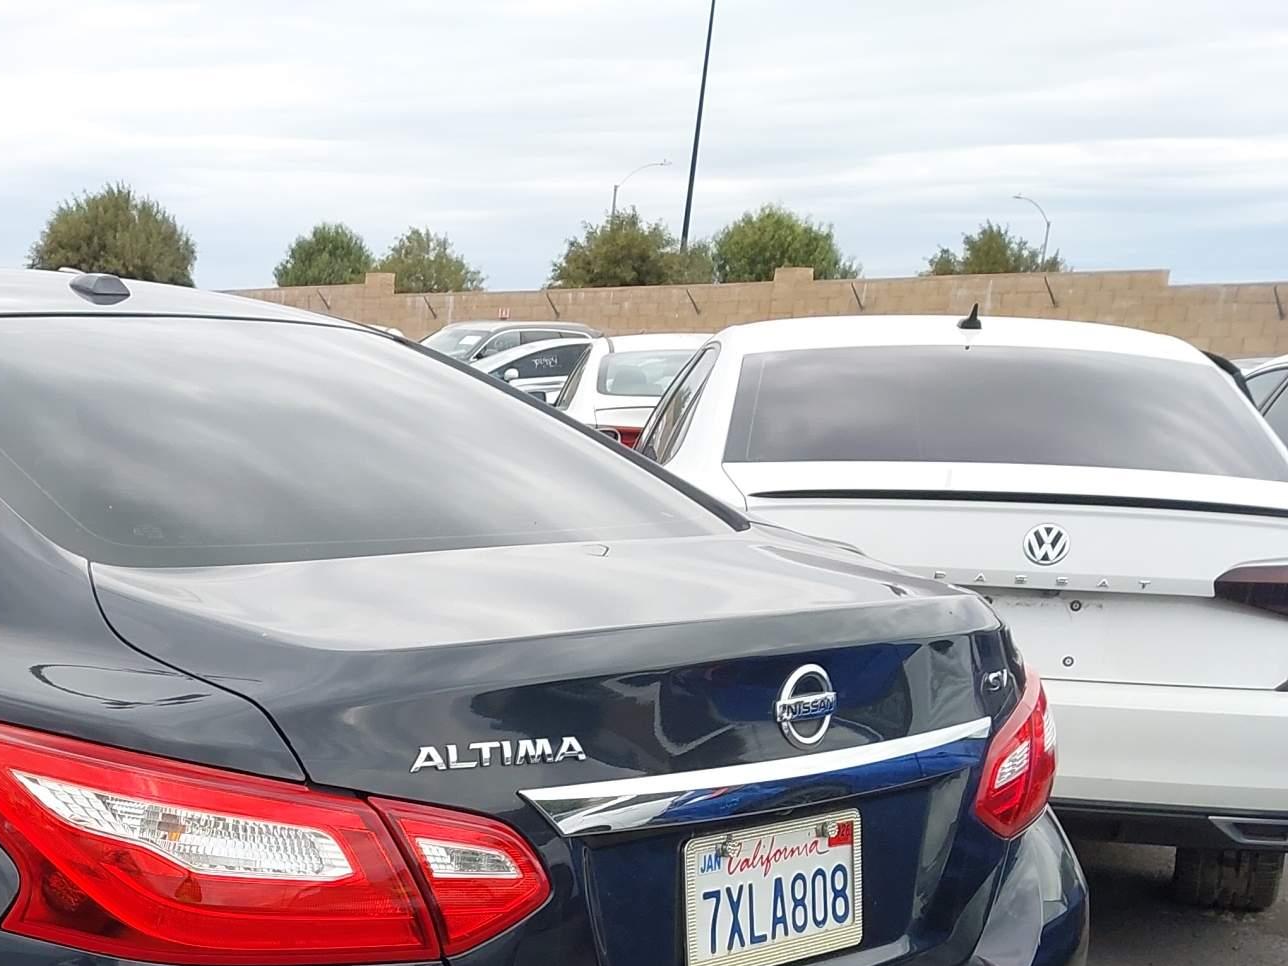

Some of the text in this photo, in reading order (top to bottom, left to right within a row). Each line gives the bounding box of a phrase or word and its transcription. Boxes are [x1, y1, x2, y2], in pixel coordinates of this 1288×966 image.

[934, 570, 1151, 590] PASSAT
[786, 697, 835, 717] NISSAN
[410, 736, 587, 773] ALTIMA
[700, 854, 722, 874] JAN
[727, 836, 829, 877] California
[702, 863, 850, 955] 7XLA808
